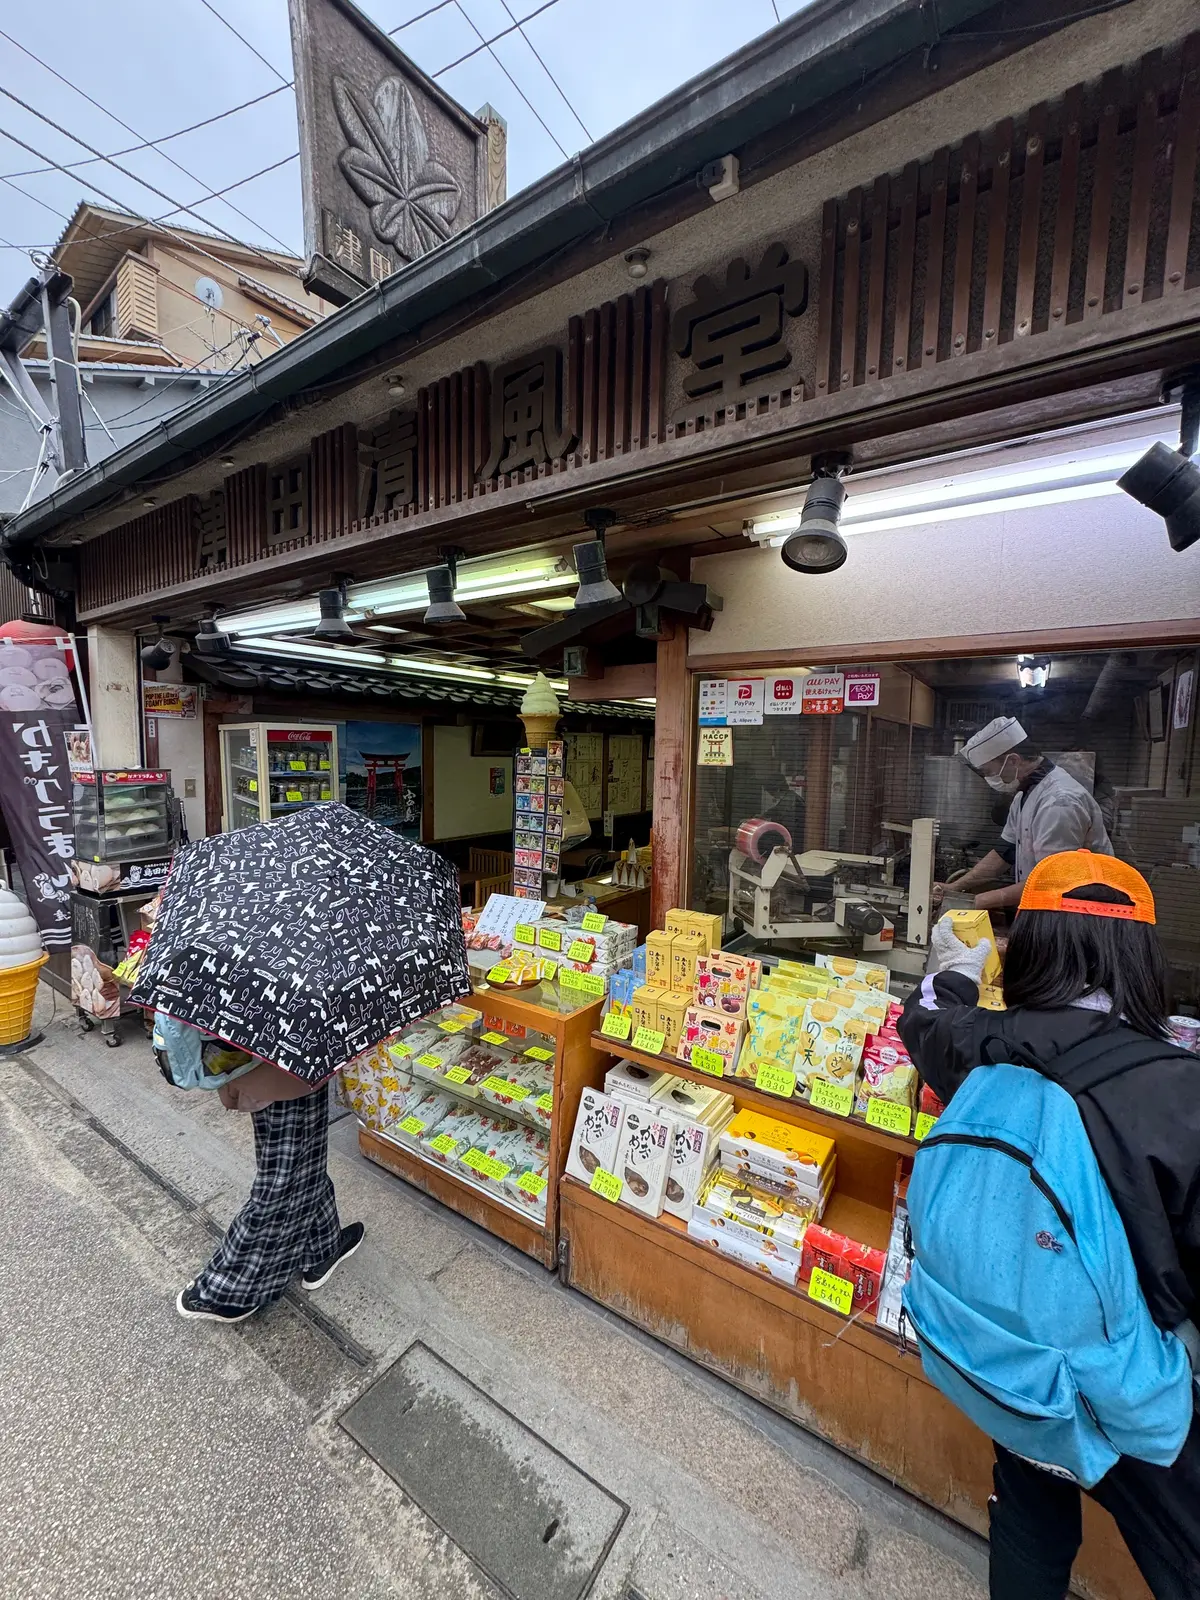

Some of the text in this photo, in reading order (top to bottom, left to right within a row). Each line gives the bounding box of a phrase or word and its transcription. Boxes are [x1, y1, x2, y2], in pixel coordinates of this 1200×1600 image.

[824, 677, 840, 685] PAY
[302, 822, 313, 830] CAT
[309, 847, 320, 855] CAT
[256, 915, 270, 923] CAT
[350, 926, 361, 936] CAT
[218, 942, 233, 952] CAT
[312, 941, 326, 951] CAT
[376, 940, 387, 950] CAT
[411, 939, 423, 948] CAT
[357, 964, 369, 974] CAT
[278, 970, 291, 980] CAT
[428, 970, 438, 979] CAT
[203, 983, 217, 993] CAT
[376, 996, 386, 1007] CAT
[263, 1011, 276, 1022] CAT
[319, 1030, 331, 1043] CAT
[802, 1021, 822, 1067] のり天
[584, 1115, 596, 1145] めし
[628, 1135, 641, 1166] めし
